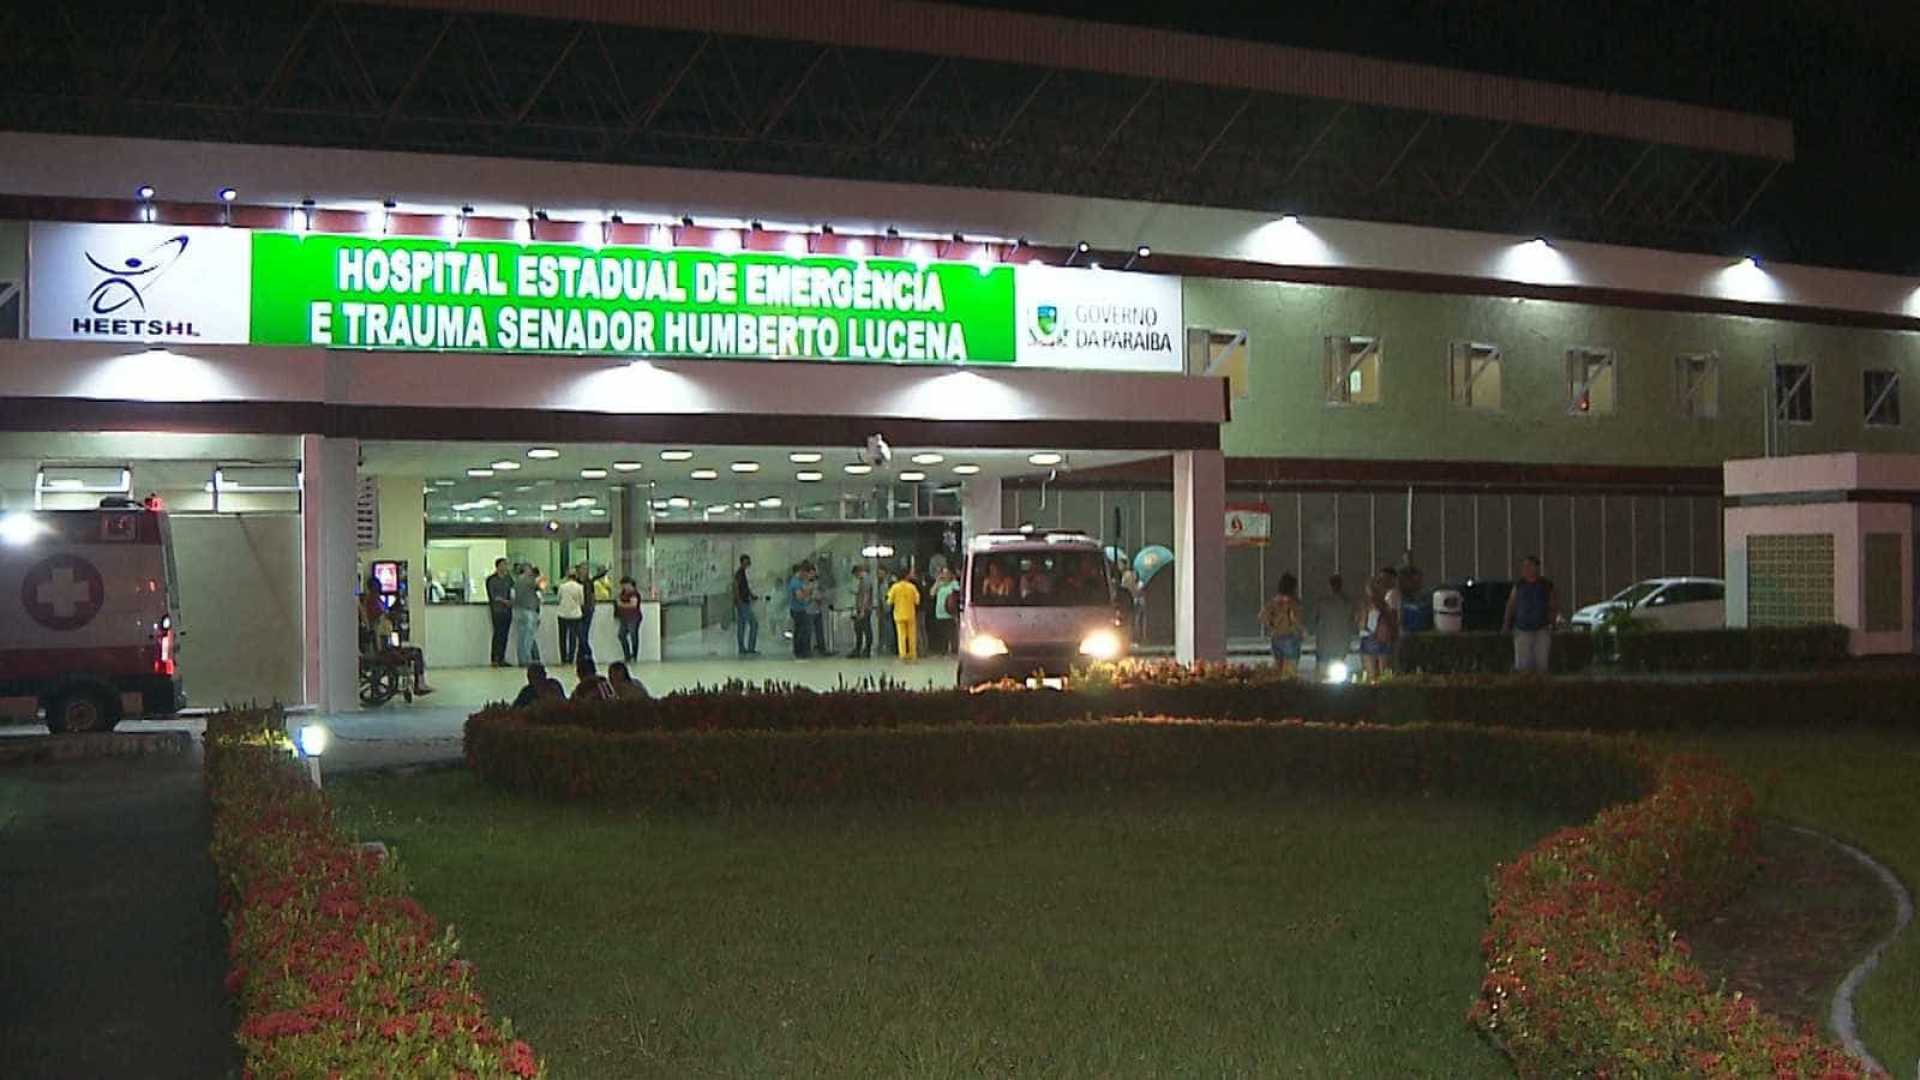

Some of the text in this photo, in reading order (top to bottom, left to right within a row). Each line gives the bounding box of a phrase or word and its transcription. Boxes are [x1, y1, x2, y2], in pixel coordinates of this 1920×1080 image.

[338, 248, 508, 296] HOSPITAL
[517, 255, 687, 303] ESTADUAL
[695, 262, 738, 304] DE
[1075, 304, 1158, 326] GOVERNO
[72, 317, 200, 337] HEETSHL
[310, 301, 967, 362] E TRAUMA SENADOR HUMBERTO LUCENA
[1076, 329, 1100, 348] DA
